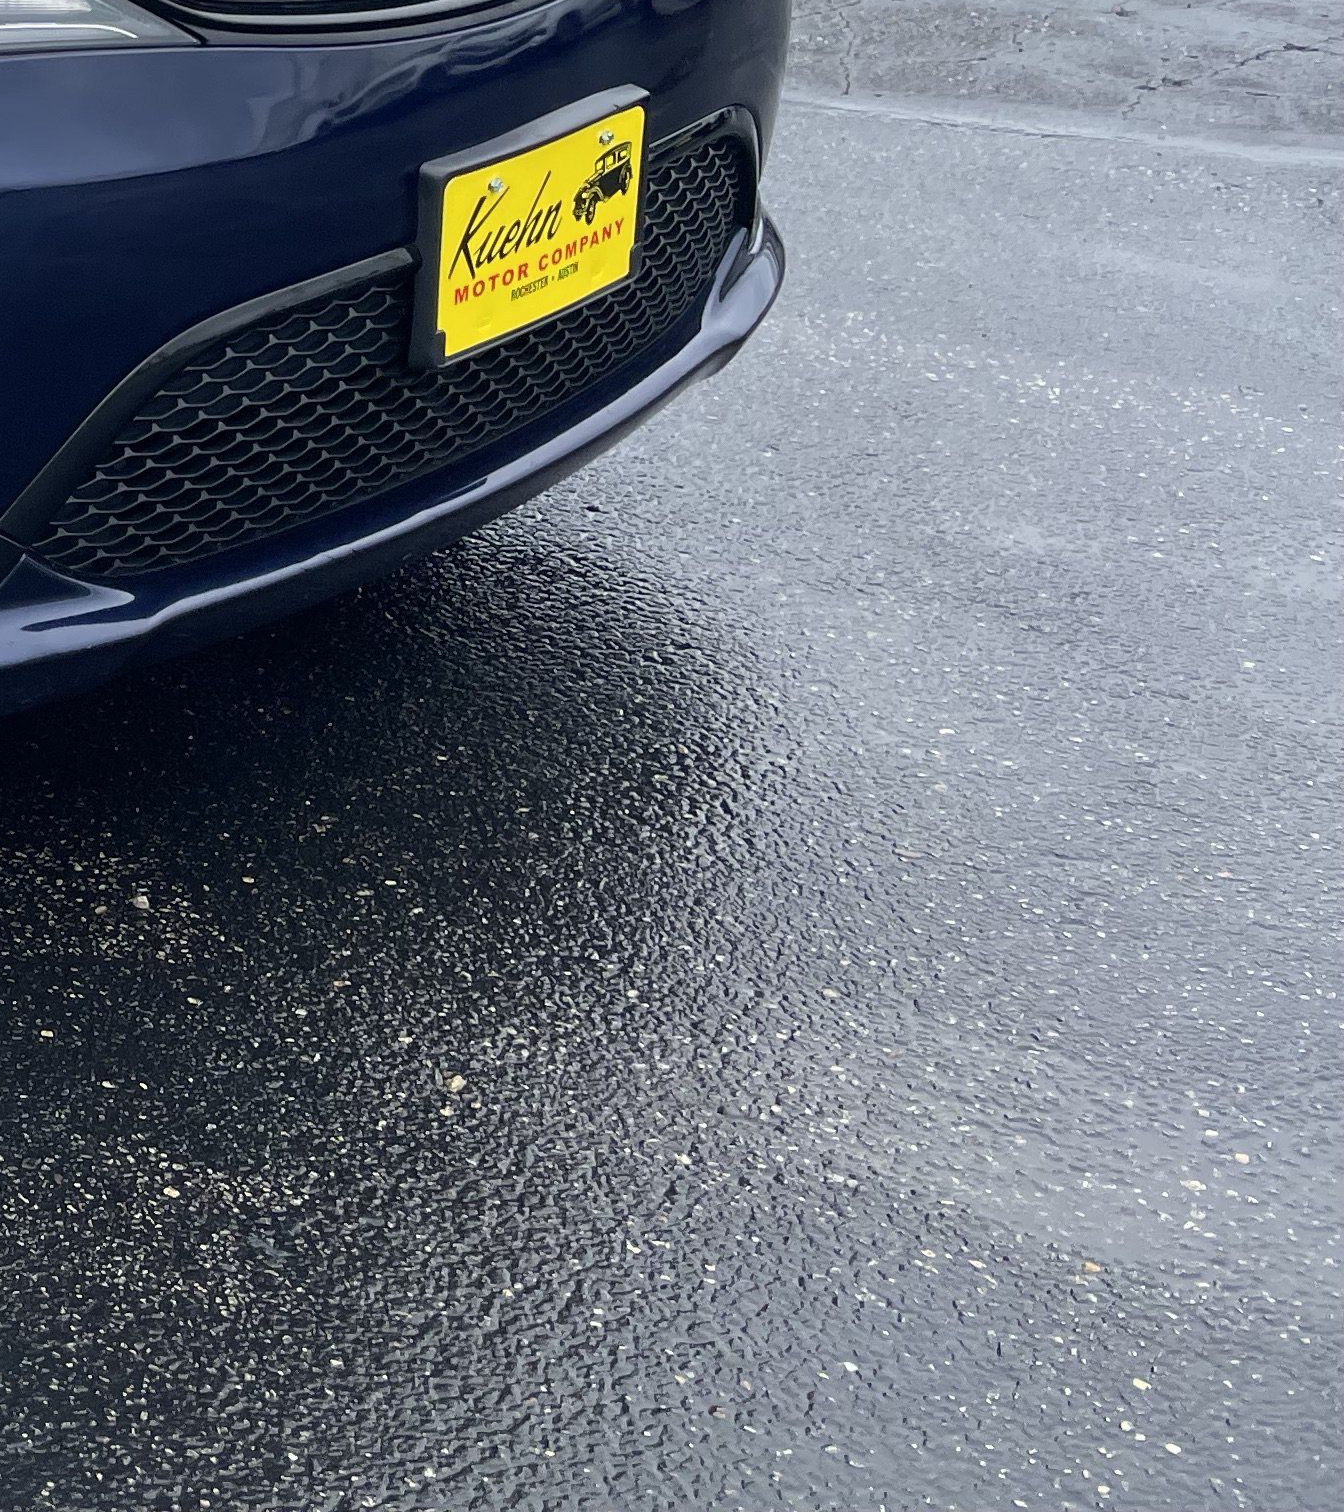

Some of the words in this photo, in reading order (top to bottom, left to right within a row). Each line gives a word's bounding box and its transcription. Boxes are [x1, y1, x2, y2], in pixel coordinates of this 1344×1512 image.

[447, 170, 563, 280] Kuehn
[453, 262, 530, 306] MOTOR
[538, 218, 626, 273] COMPANY
[510, 276, 549, 301] ROCHESTER
[557, 261, 579, 281] AUSTIN
